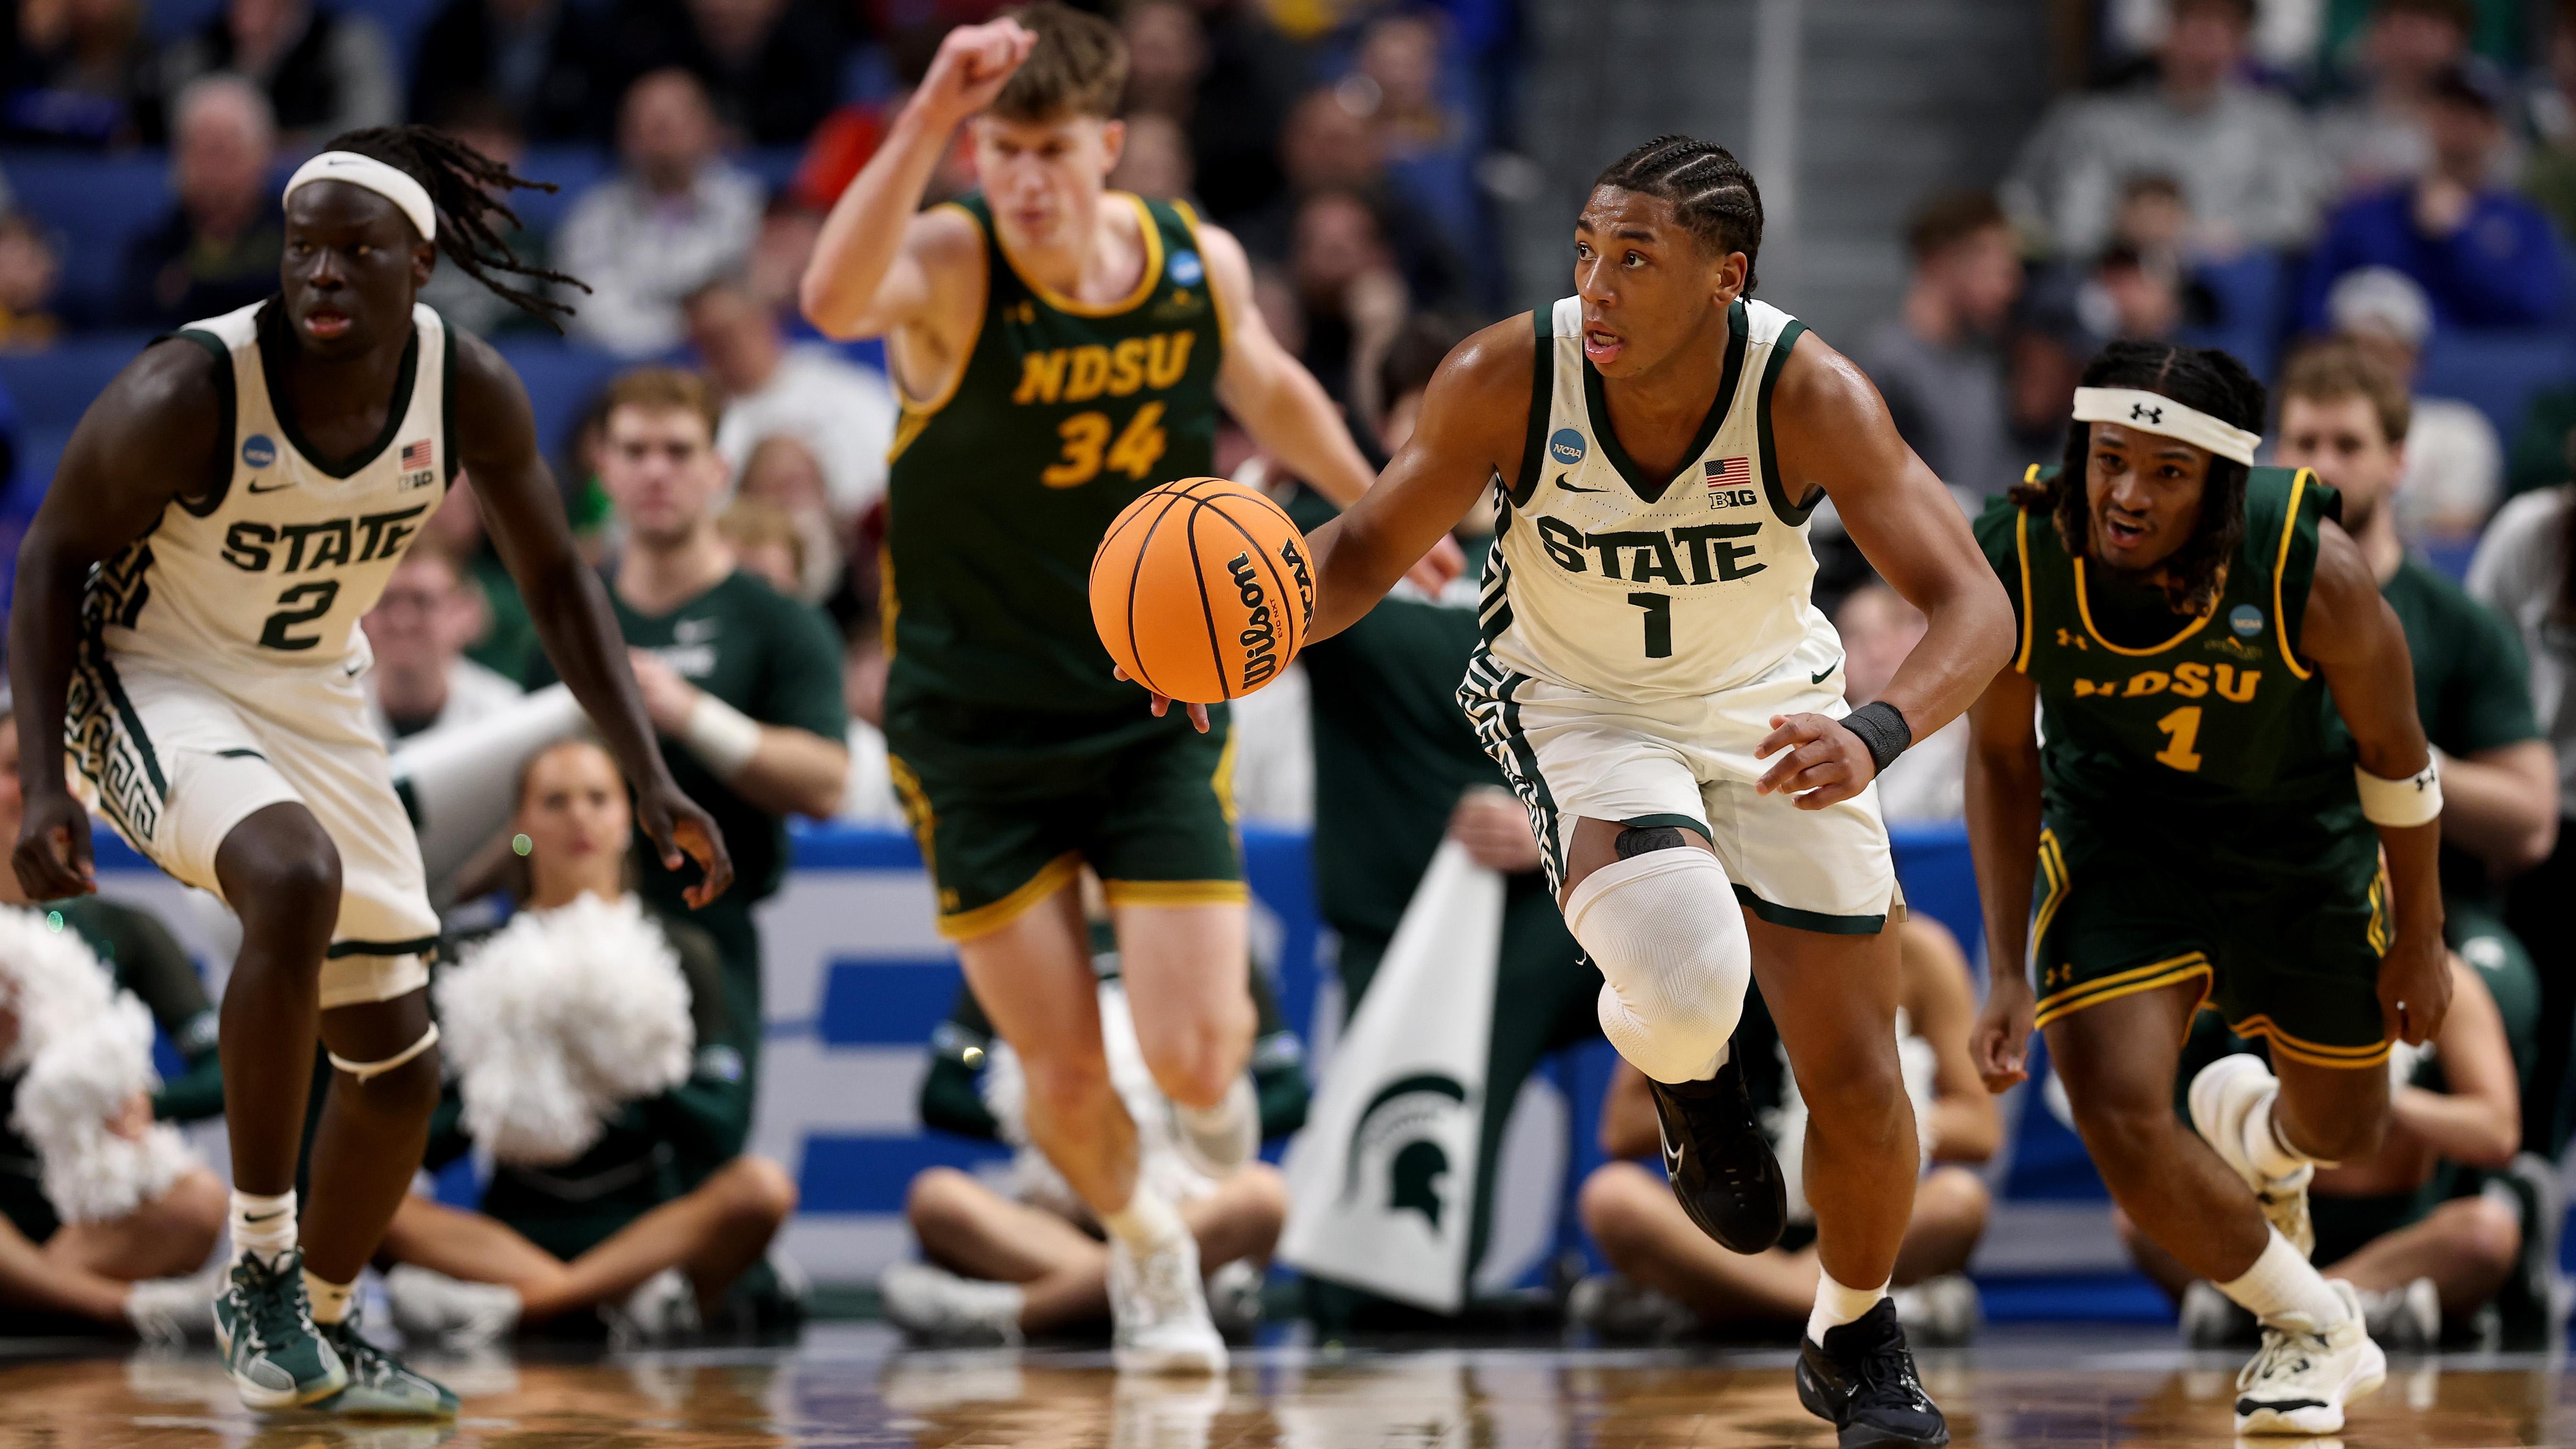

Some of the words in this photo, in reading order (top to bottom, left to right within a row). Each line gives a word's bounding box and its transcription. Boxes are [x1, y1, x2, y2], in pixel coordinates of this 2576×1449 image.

[1012, 330, 1196, 405] NDSU
[1040, 400, 1167, 489] 34
[1553, 443, 1582, 458] NCAA
[221, 503, 428, 574] STATE
[1537, 515, 1768, 586] STATE
[260, 579, 340, 650] 2
[1227, 551, 1276, 689] Wilson
[1269, 599, 1279, 618] NXT
[1280, 537, 1313, 638] NCAA
[1628, 592, 1673, 659] 1
[2156, 706, 2202, 772] 1
